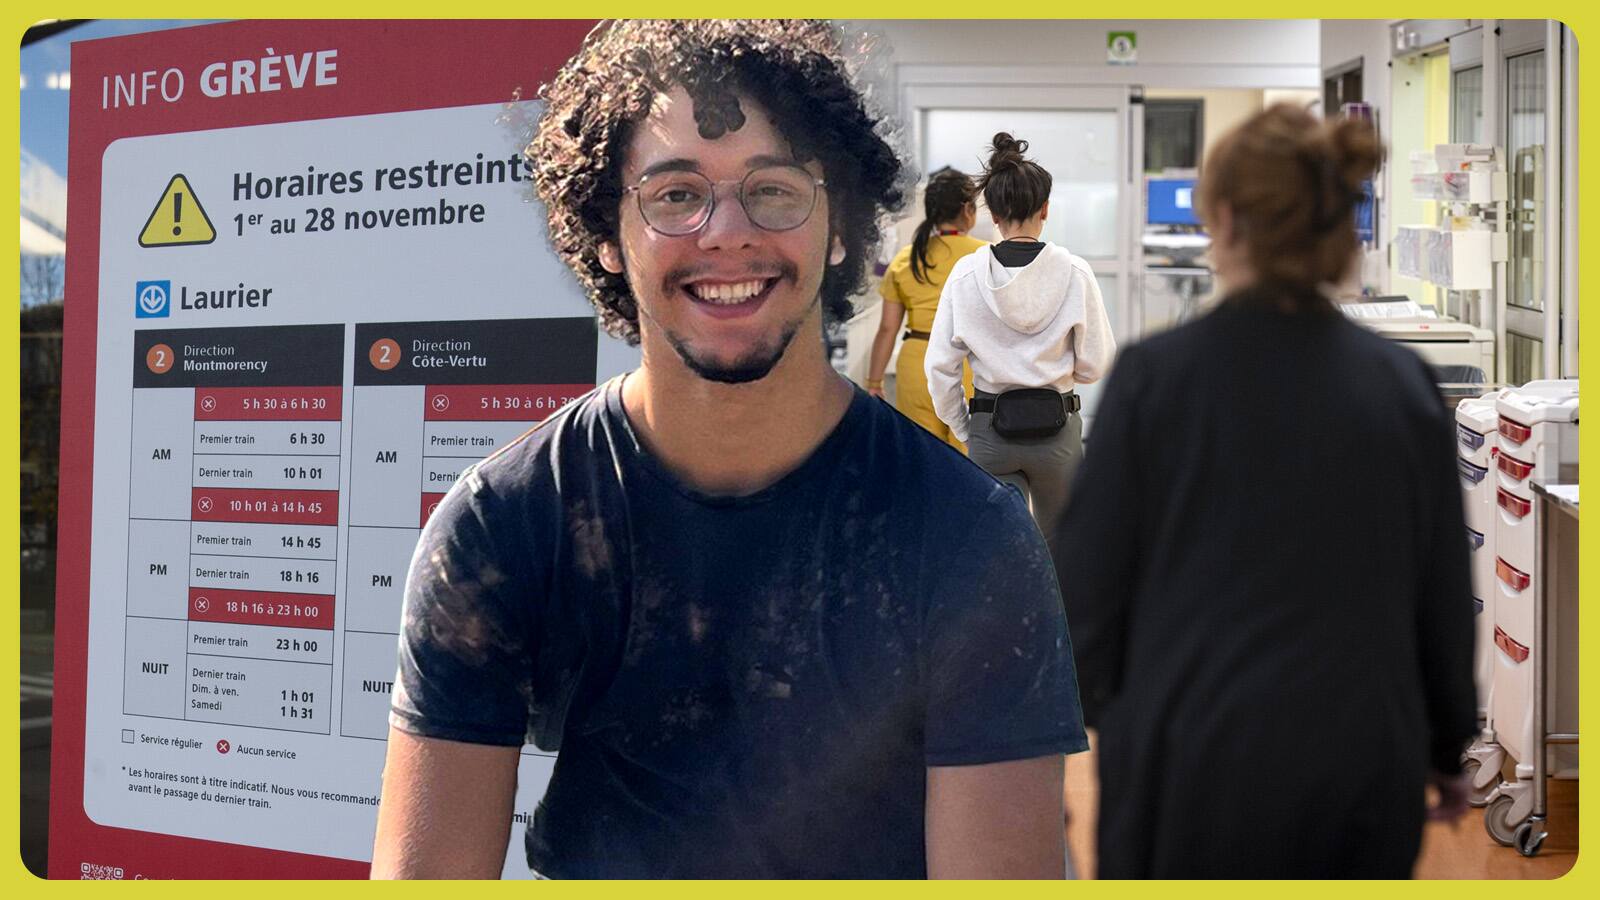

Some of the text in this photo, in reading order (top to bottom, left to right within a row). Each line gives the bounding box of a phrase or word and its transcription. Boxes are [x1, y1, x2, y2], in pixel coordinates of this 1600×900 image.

[102, 48, 338, 109] INFO GRÈVE
[233, 166, 363, 201] Horaires
[270, 218, 296, 234] au
[304, 207, 335, 232] 28
[344, 198, 486, 230] novembre
[180, 283, 272, 310] Laurier
[184, 345, 235, 357] Direction
[412, 339, 471, 352] Direction
[155, 350, 166, 367] 2
[379, 345, 392, 364] 2
[412, 354, 487, 368] Côte-Vertu
[183, 359, 268, 372] Montmorency
[243, 397, 326, 409] 5 h 30 à 6 h 30
[481, 397, 489, 409] 5
[492, 397, 500, 409] h
[504, 397, 520, 409] 30
[524, 396, 532, 409] à
[535, 397, 544, 409] 6
[548, 396, 556, 409] h
[200, 433, 325, 445] Premier train 6 h 30
[431, 436, 494, 446] Premier train
[152, 449, 171, 460] AM
[375, 451, 397, 463] AM
[199, 467, 322, 479] Dernier train 10 h 01
[230, 500, 322, 514] 10 h 01 à 14 h 45
[197, 534, 321, 549] Premier train 14 h 45
[150, 564, 167, 575] PM
[196, 568, 319, 584] Dernier train 18 h 16
[372, 575, 392, 587] PM
[226, 601, 319, 618] 18 h 16 à 23 h 00
[193, 635, 318, 652] Premier train 23 h 00
[142, 662, 169, 675] NUIT
[192, 668, 246, 681] Dernier train
[192, 684, 314, 703] Dim. à ven. 1 h 01
[362, 680, 393, 694] NUIT
[191, 699, 314, 719] Samedi 1 h 31
[140, 734, 203, 750] Service régulier
[236, 744, 297, 760] Aucun service
[128, 767, 142, 778] Les
[144, 769, 178, 782] horaires
[180, 776, 199, 785] sont
[201, 775, 207, 785] à
[209, 777, 228, 788] titre
[229, 779, 268, 793] indicatif.
[271, 784, 295, 796] Nous
[297, 789, 319, 799] vous
[128, 783, 273, 809] avant le passage du dernier train.
